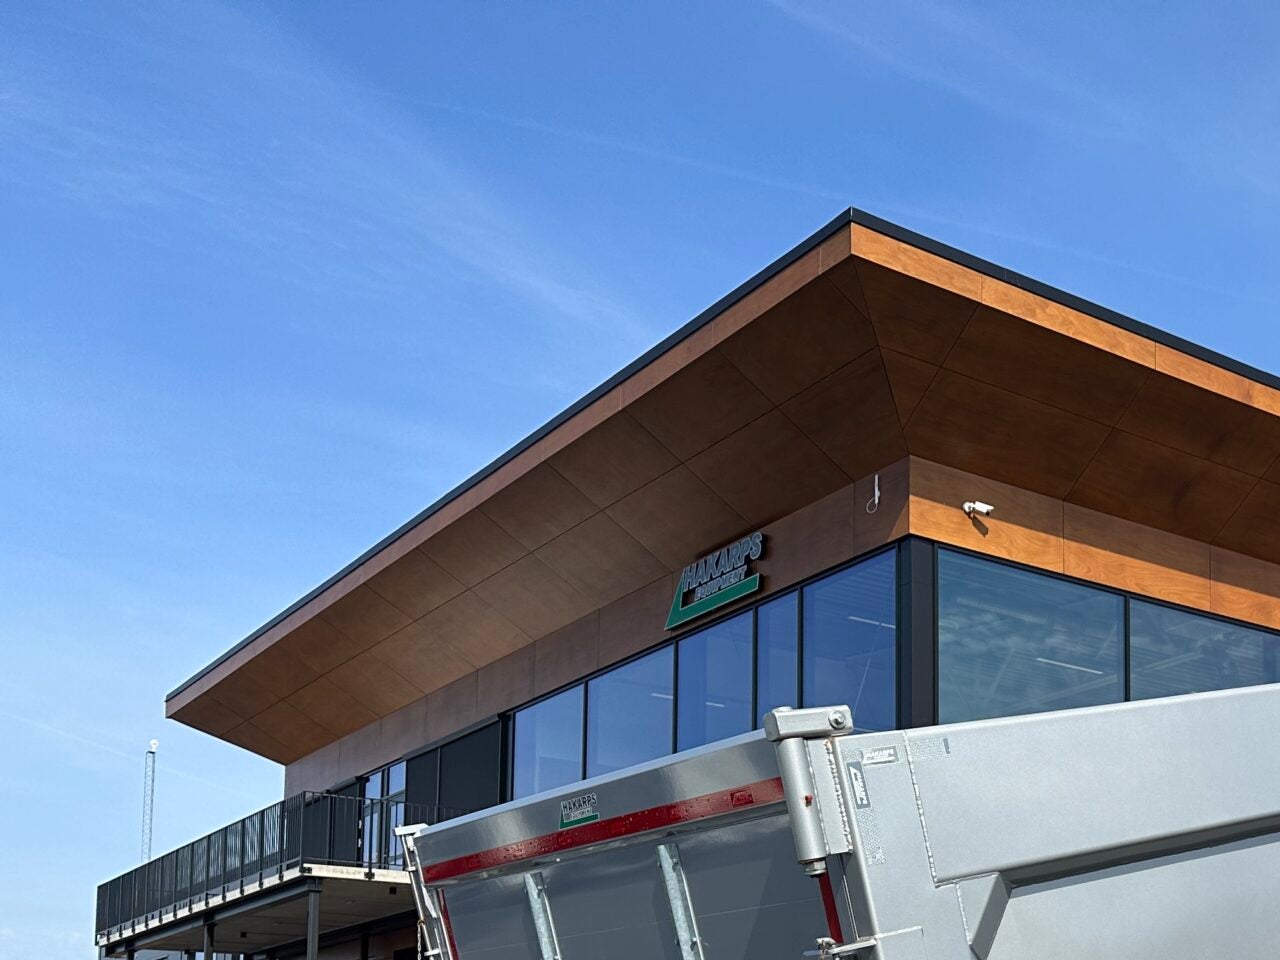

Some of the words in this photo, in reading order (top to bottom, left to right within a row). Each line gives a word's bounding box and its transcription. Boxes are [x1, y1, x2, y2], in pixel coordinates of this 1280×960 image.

[682, 531, 763, 593] HAKARPS
[694, 564, 748, 601] EQUIPMENT
[561, 793, 598, 813] HAKARPS
